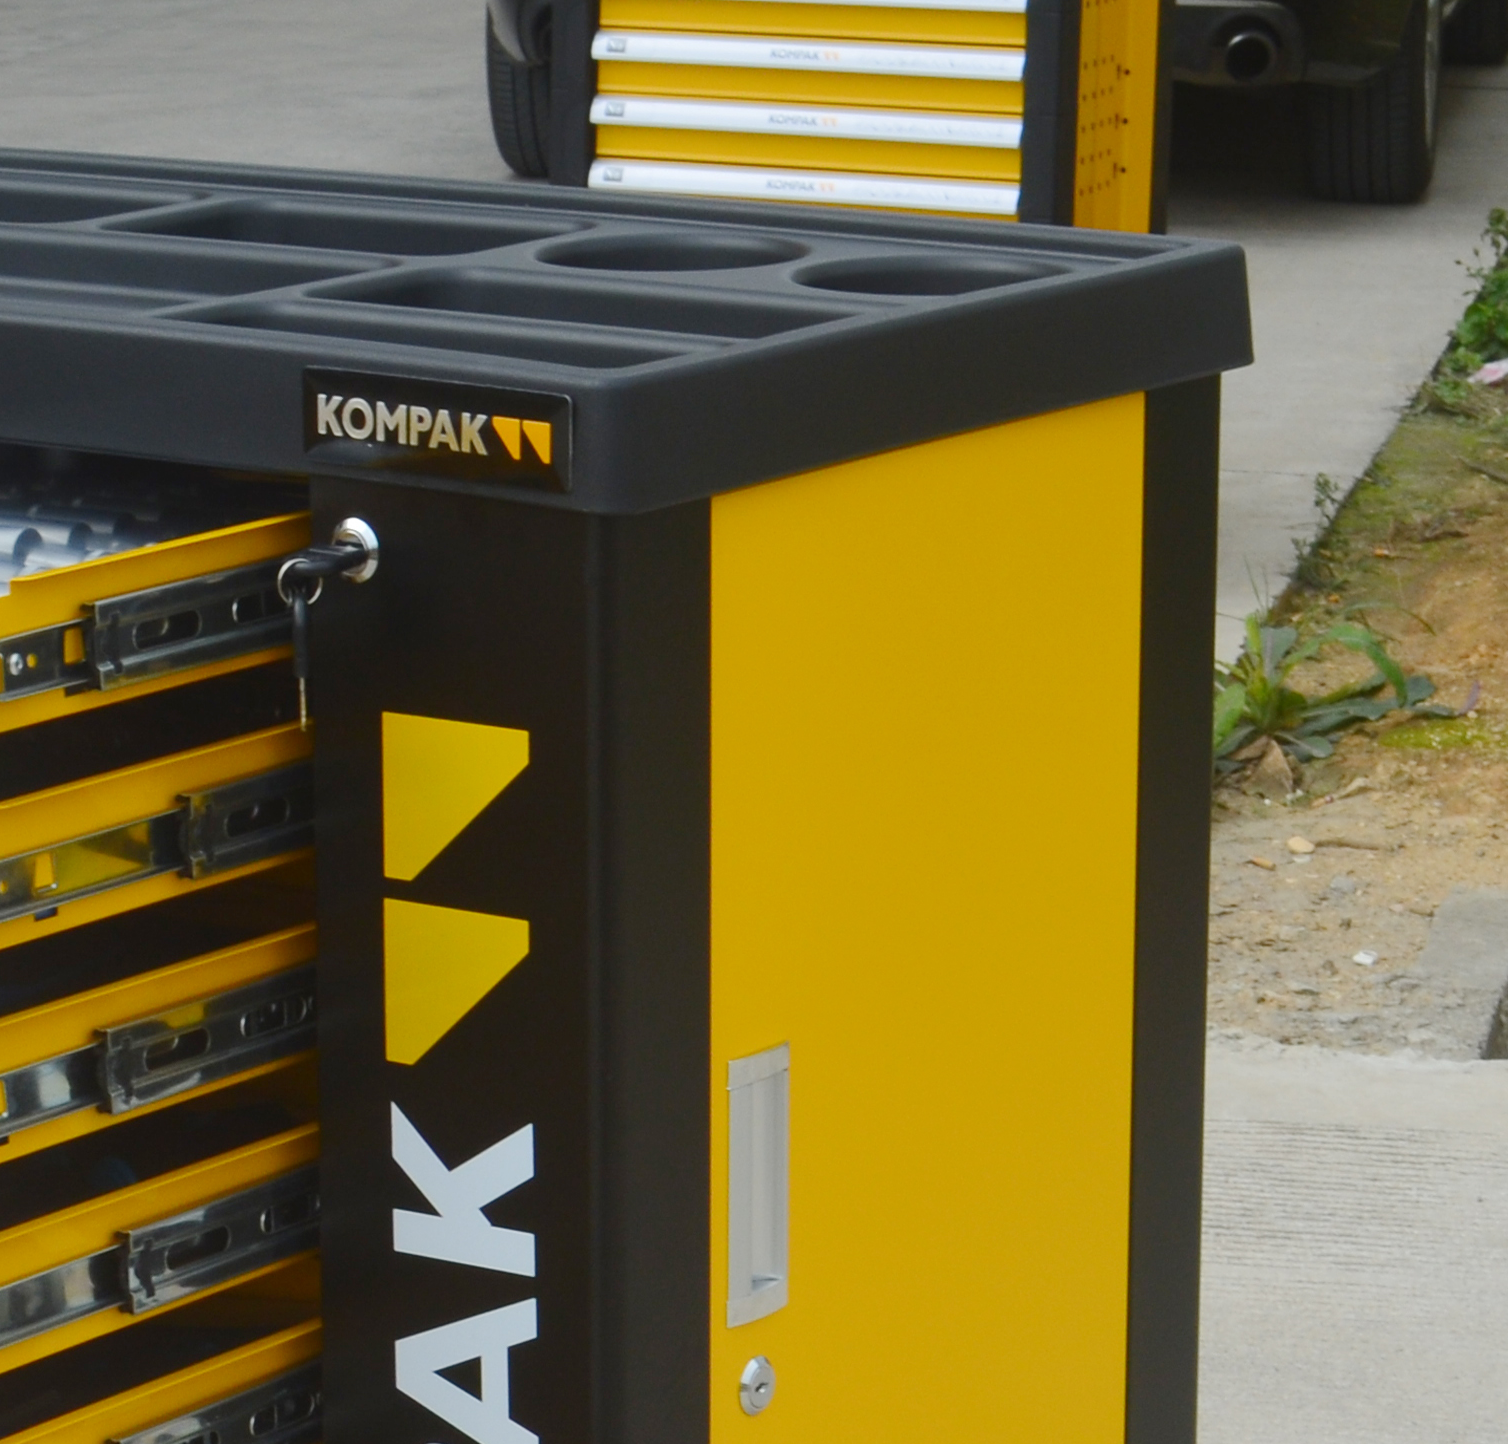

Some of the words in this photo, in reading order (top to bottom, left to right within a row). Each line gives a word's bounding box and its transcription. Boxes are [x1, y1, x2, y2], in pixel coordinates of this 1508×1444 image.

[769, 48, 820, 61] KOMPAK
[768, 114, 818, 126] KOMPAK
[765, 179, 816, 191] KOMPAK
[316, 393, 489, 456] KOMPAK
